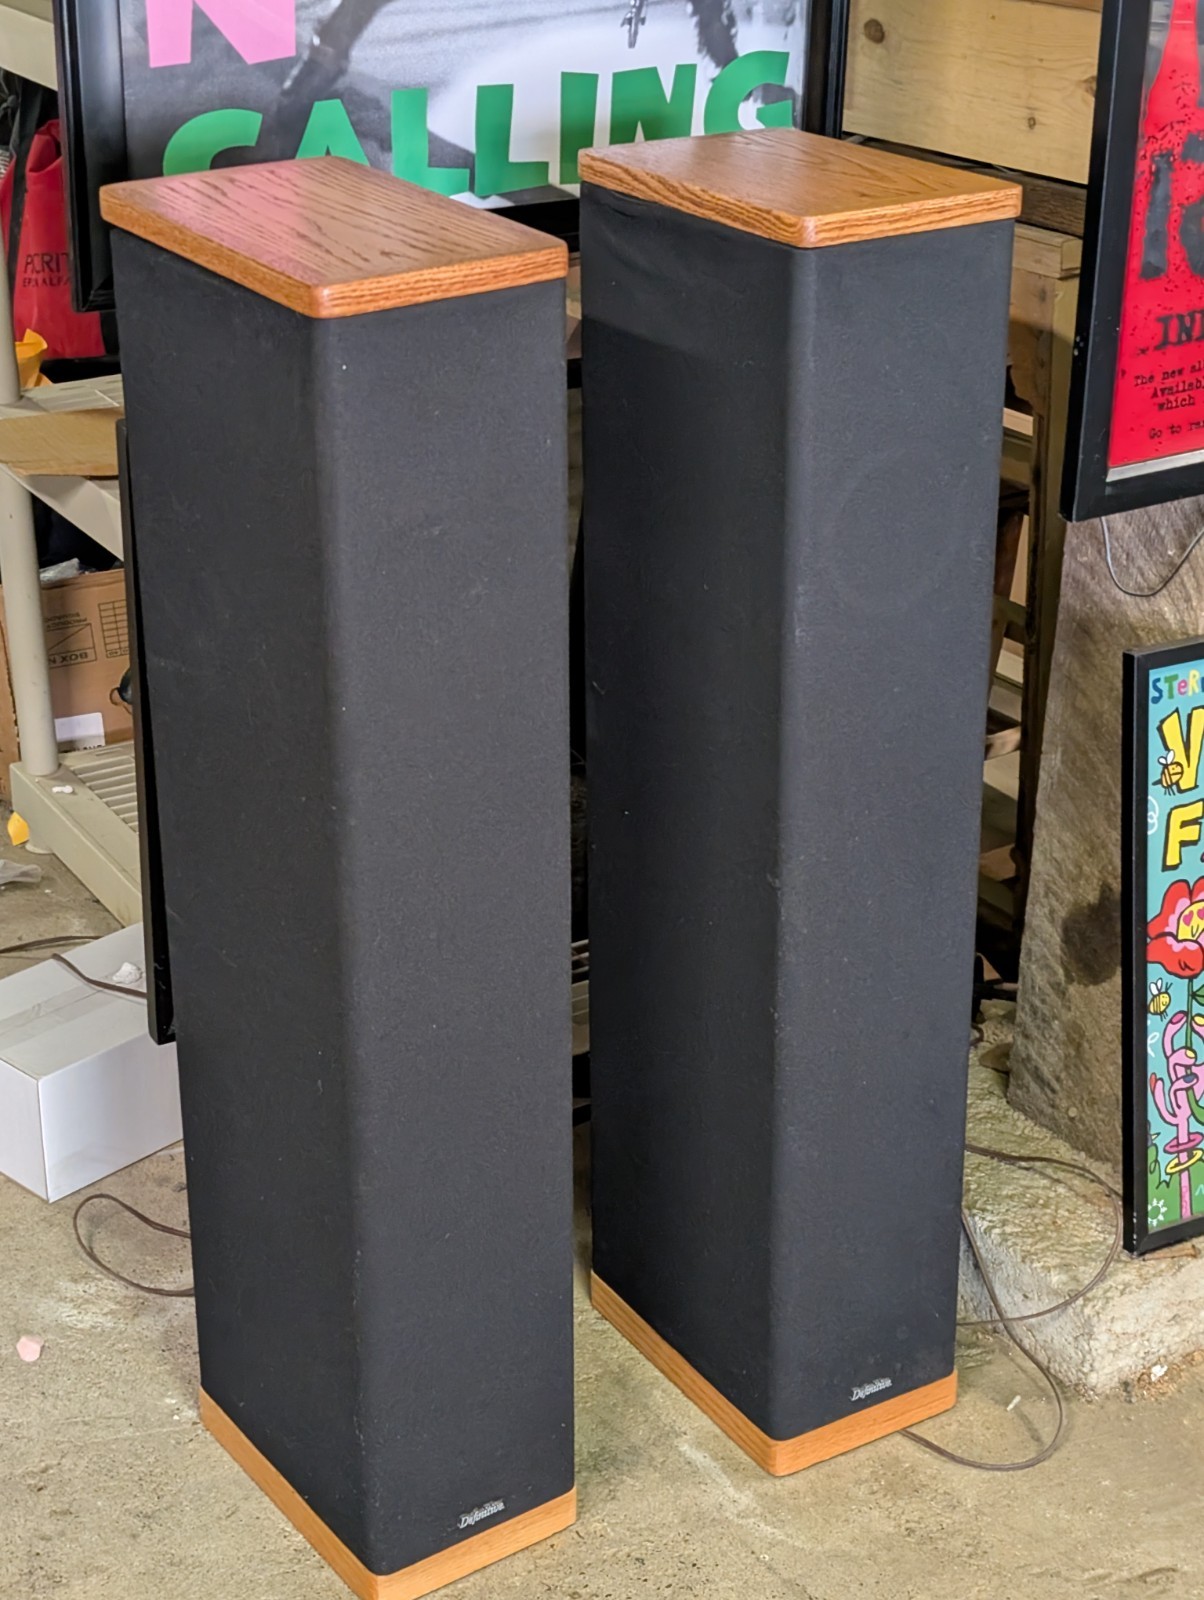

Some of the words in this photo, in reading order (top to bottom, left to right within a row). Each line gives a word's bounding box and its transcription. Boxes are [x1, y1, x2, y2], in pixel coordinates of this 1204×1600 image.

[1154, 309, 1204, 351] IN
[1190, 360, 1204, 373] al
[1151, 376, 1204, 399] Availab
[1157, 394, 1195, 411] which
[1169, 423, 1182, 434] to
[60, 651, 88, 663] BOX
